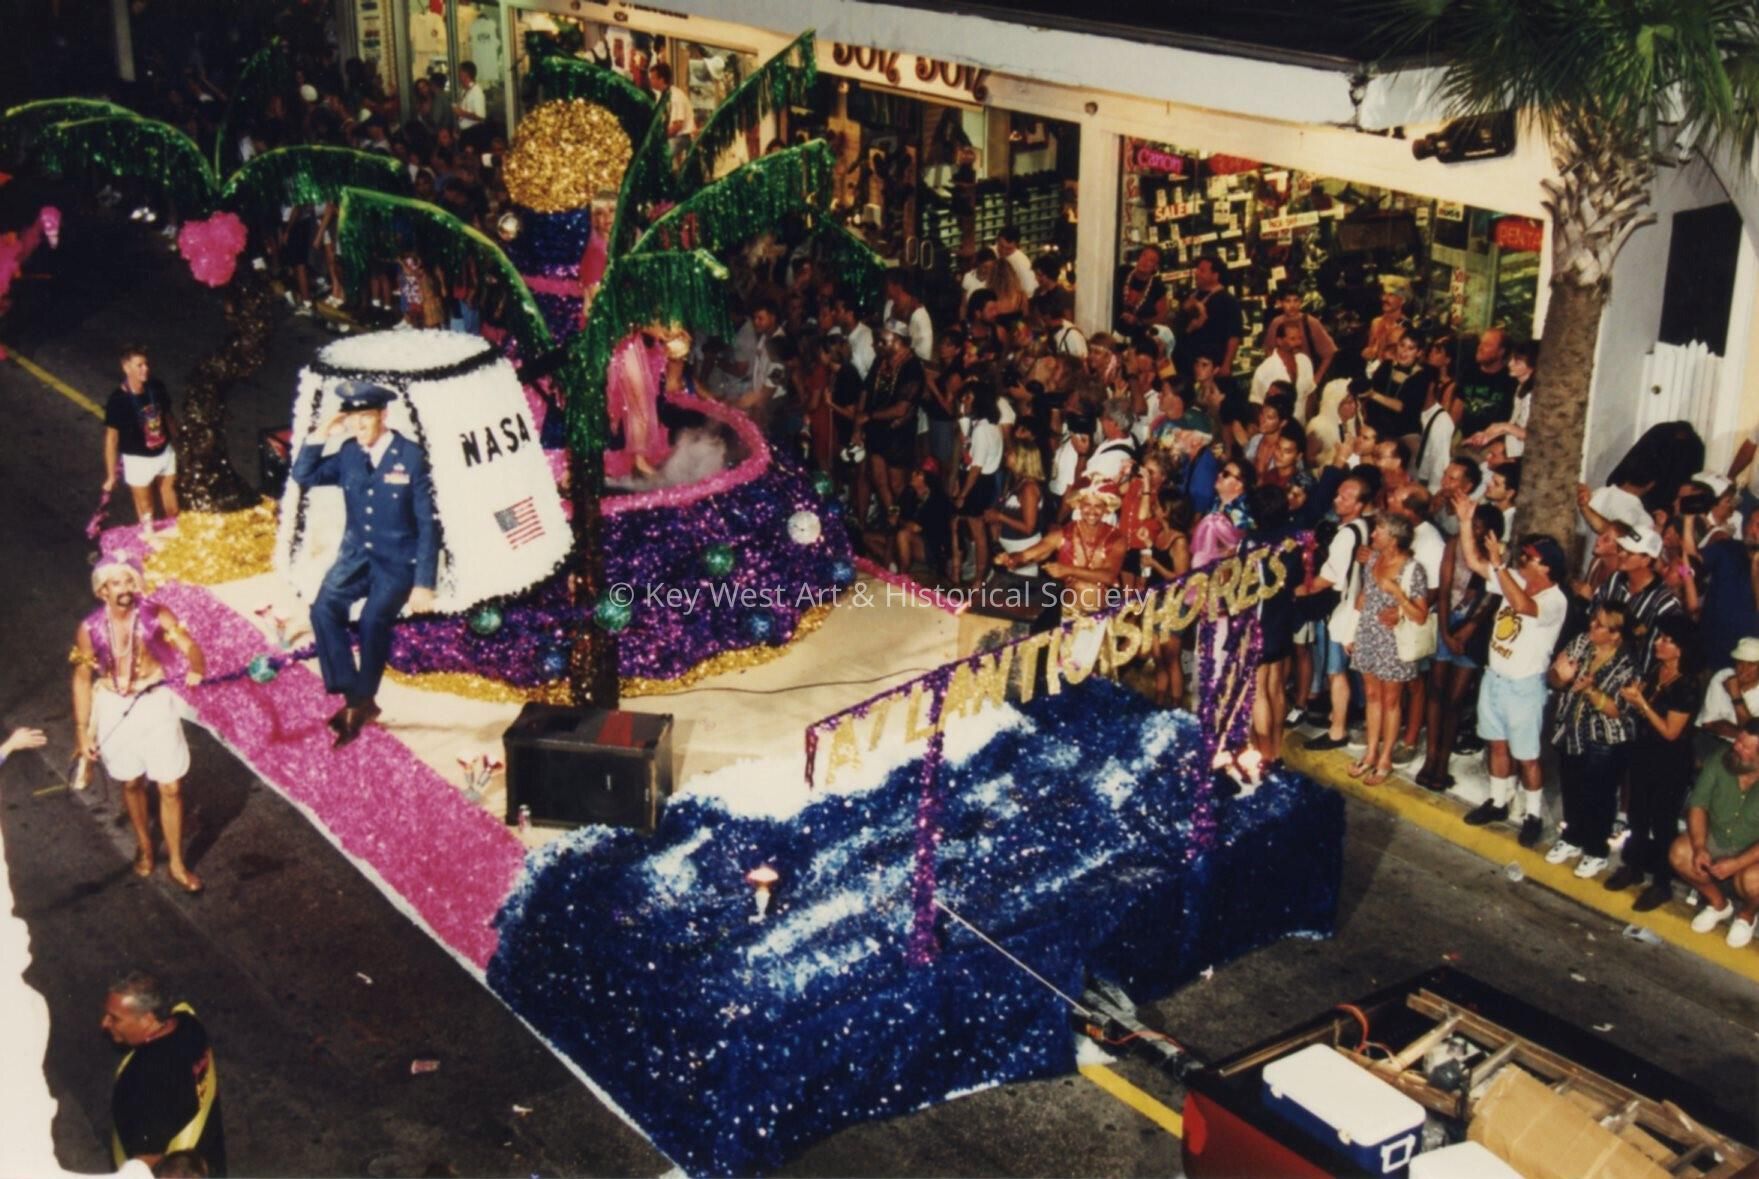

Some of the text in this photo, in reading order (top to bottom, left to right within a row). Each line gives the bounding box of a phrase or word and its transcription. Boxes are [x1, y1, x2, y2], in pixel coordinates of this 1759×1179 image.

[1137, 145, 1183, 174] Canon
[459, 412, 531, 468] NASA
[824, 537, 1297, 786] ATLANTIC SHORES
